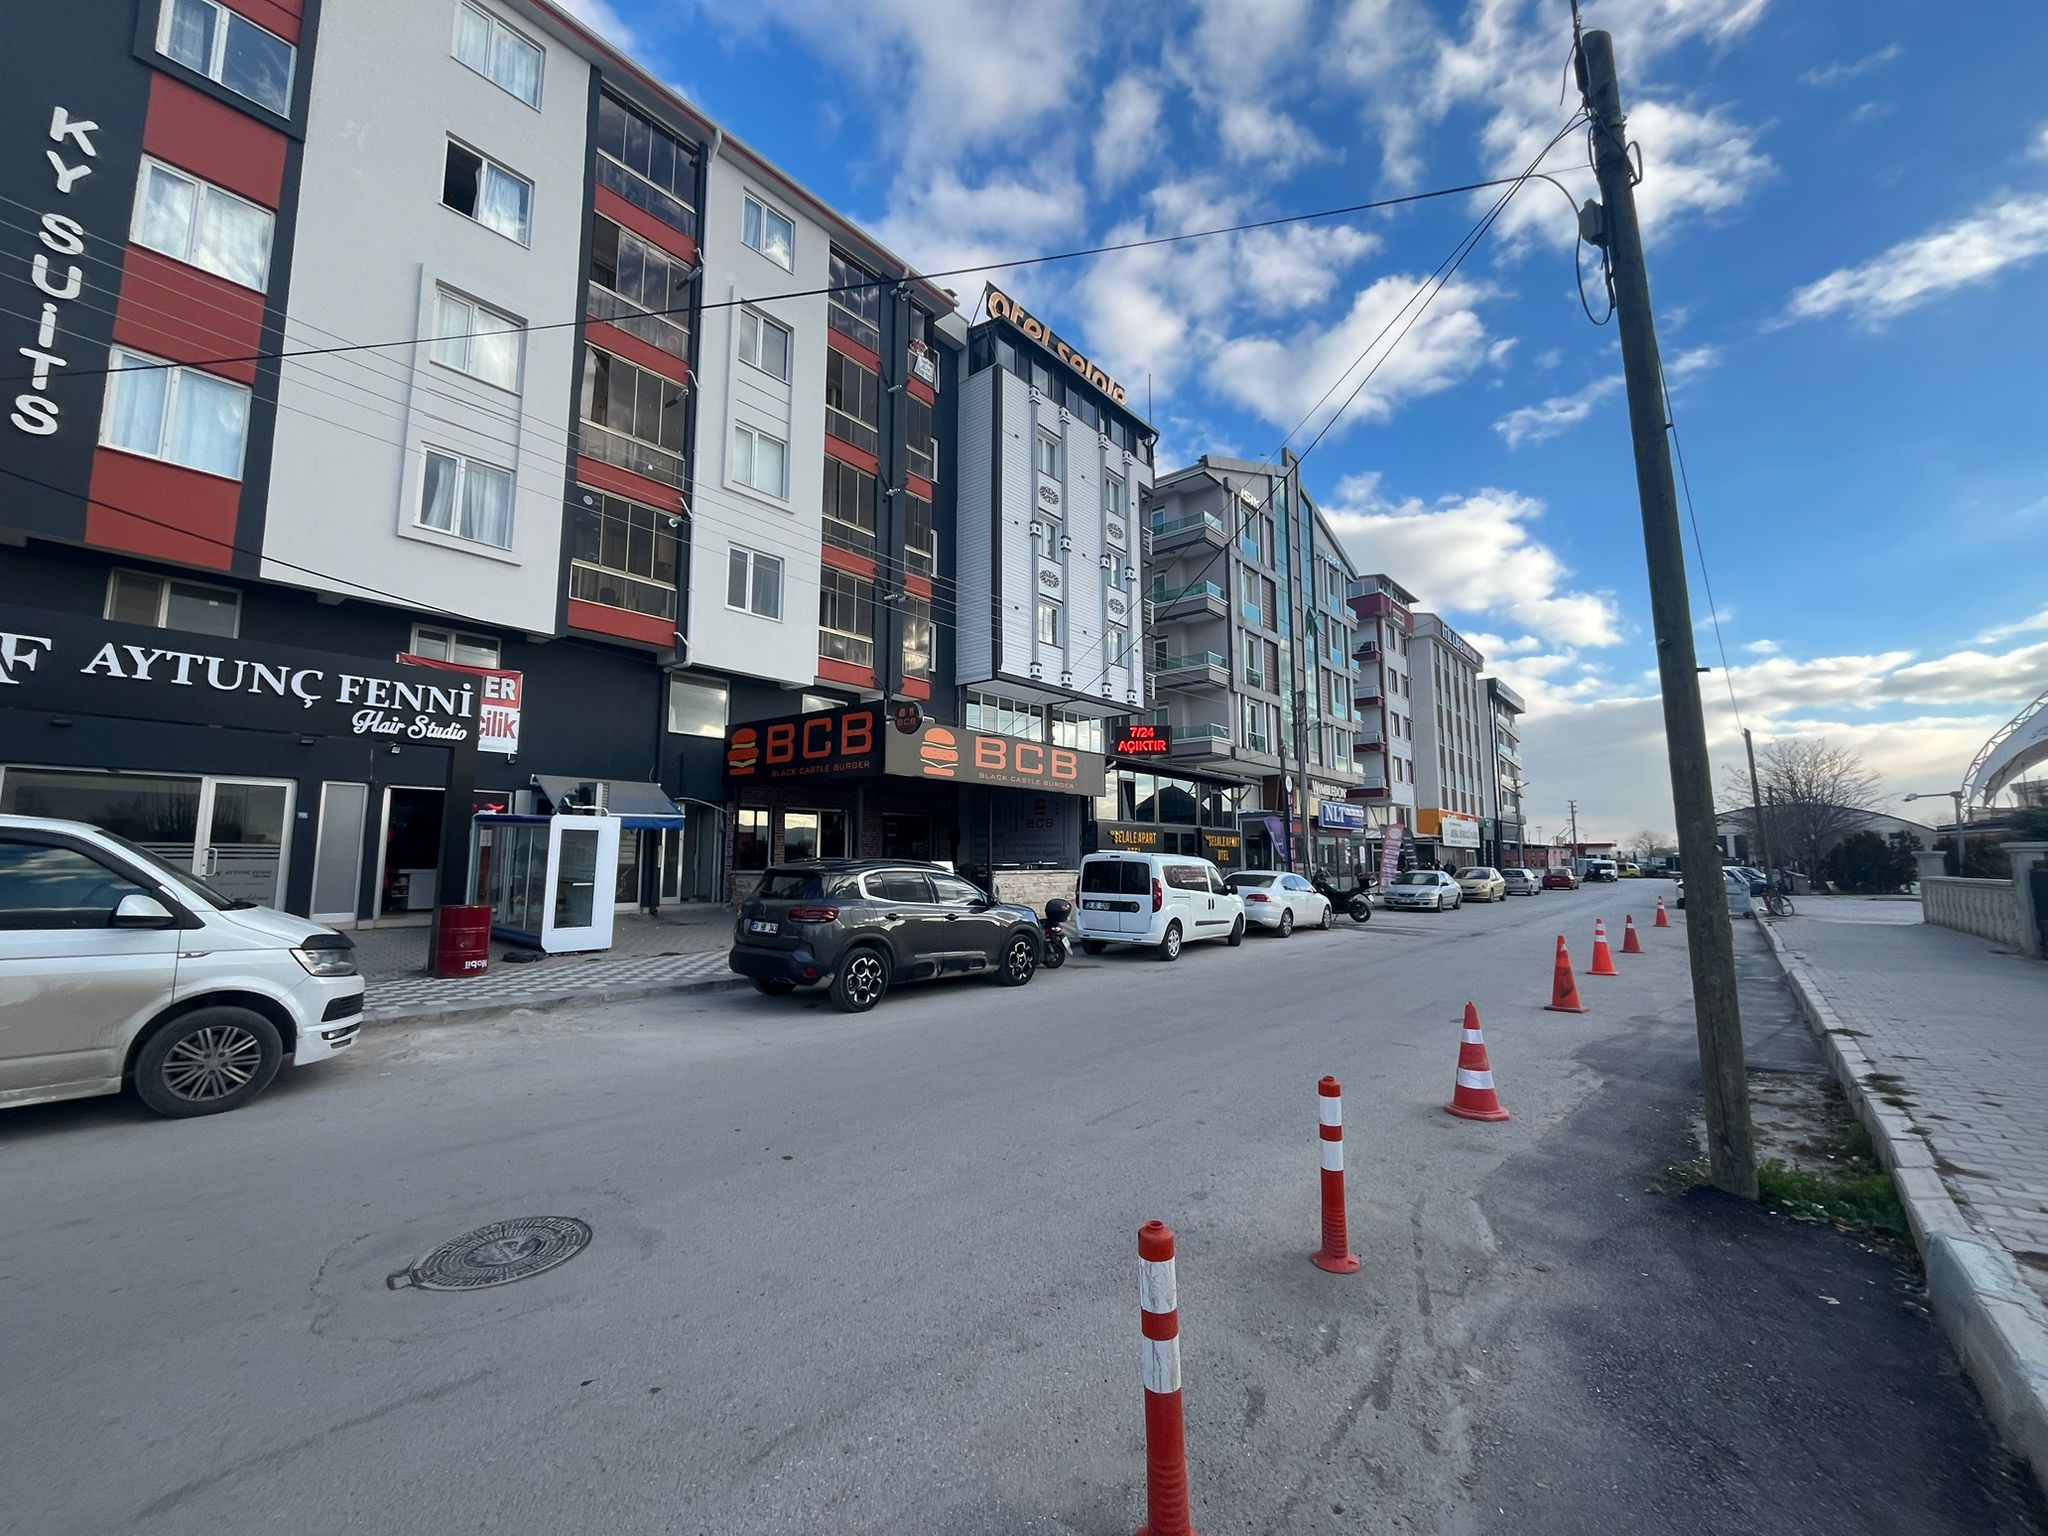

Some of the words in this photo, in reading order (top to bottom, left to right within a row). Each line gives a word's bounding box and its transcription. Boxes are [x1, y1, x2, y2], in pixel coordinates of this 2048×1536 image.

[80, 642, 324, 708] AYTUNÇ
[336, 674, 475, 718] FENNİ
[351, 709, 406, 735] Hair
[407, 714, 468, 742] Studio
[1129, 727, 1155, 738] 7/24
[766, 711, 873, 764] BCB
[1117, 740, 1167, 753] AÇIKTIR
[975, 736, 1078, 780] BCB
[771, 767, 797, 778] BLACK
[800, 763, 831, 775] CASTLE
[833, 760, 871, 772] BURGER
[978, 771, 1008, 782] BLACK
[1010, 776, 1041, 786] CASTLE
[1043, 780, 1075, 790] BURGER
[1323, 804, 1345, 823] NLT
[464, 959, 488, 970] Mobil
